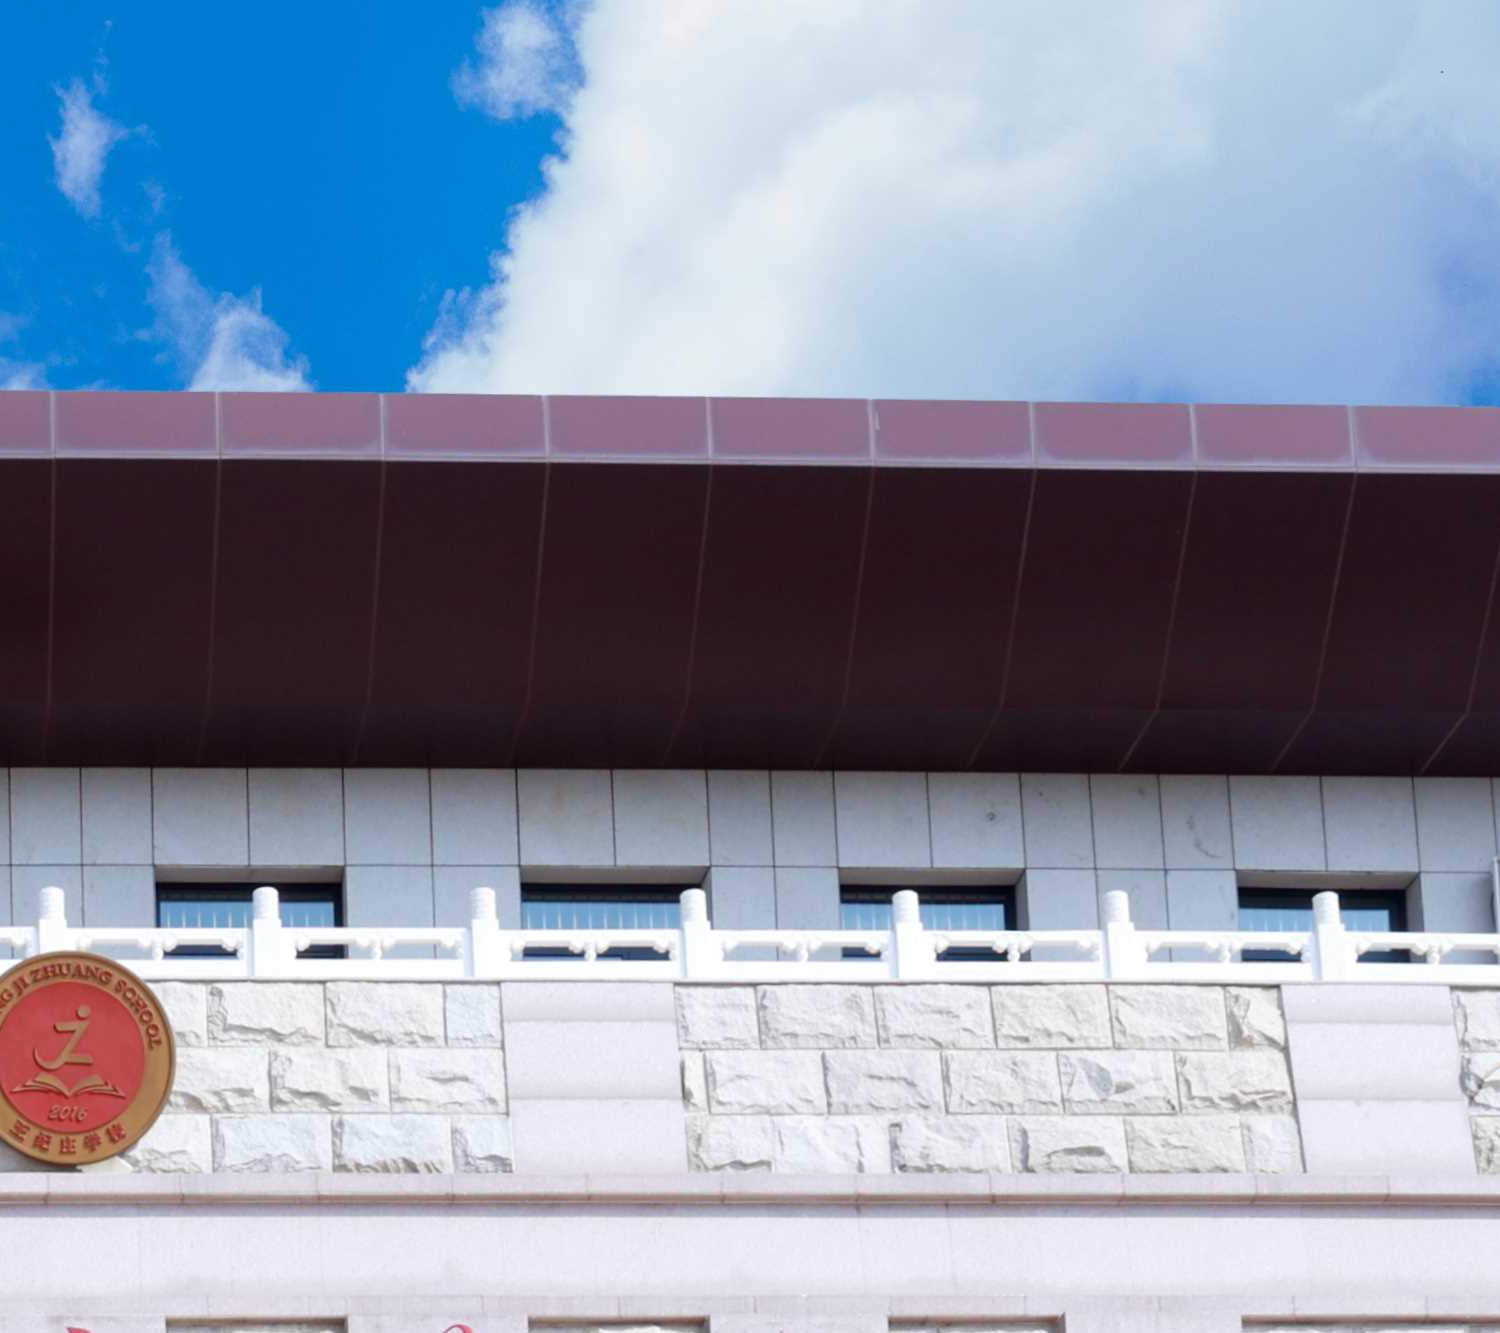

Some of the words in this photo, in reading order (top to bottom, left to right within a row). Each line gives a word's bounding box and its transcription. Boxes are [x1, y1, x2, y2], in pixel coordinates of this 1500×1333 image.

[12, 975, 30, 996] JI
[30, 962, 113, 986] ZHUANG
[114, 979, 162, 1050] SCHOOL
[47, 1104, 89, 1123] 2016
